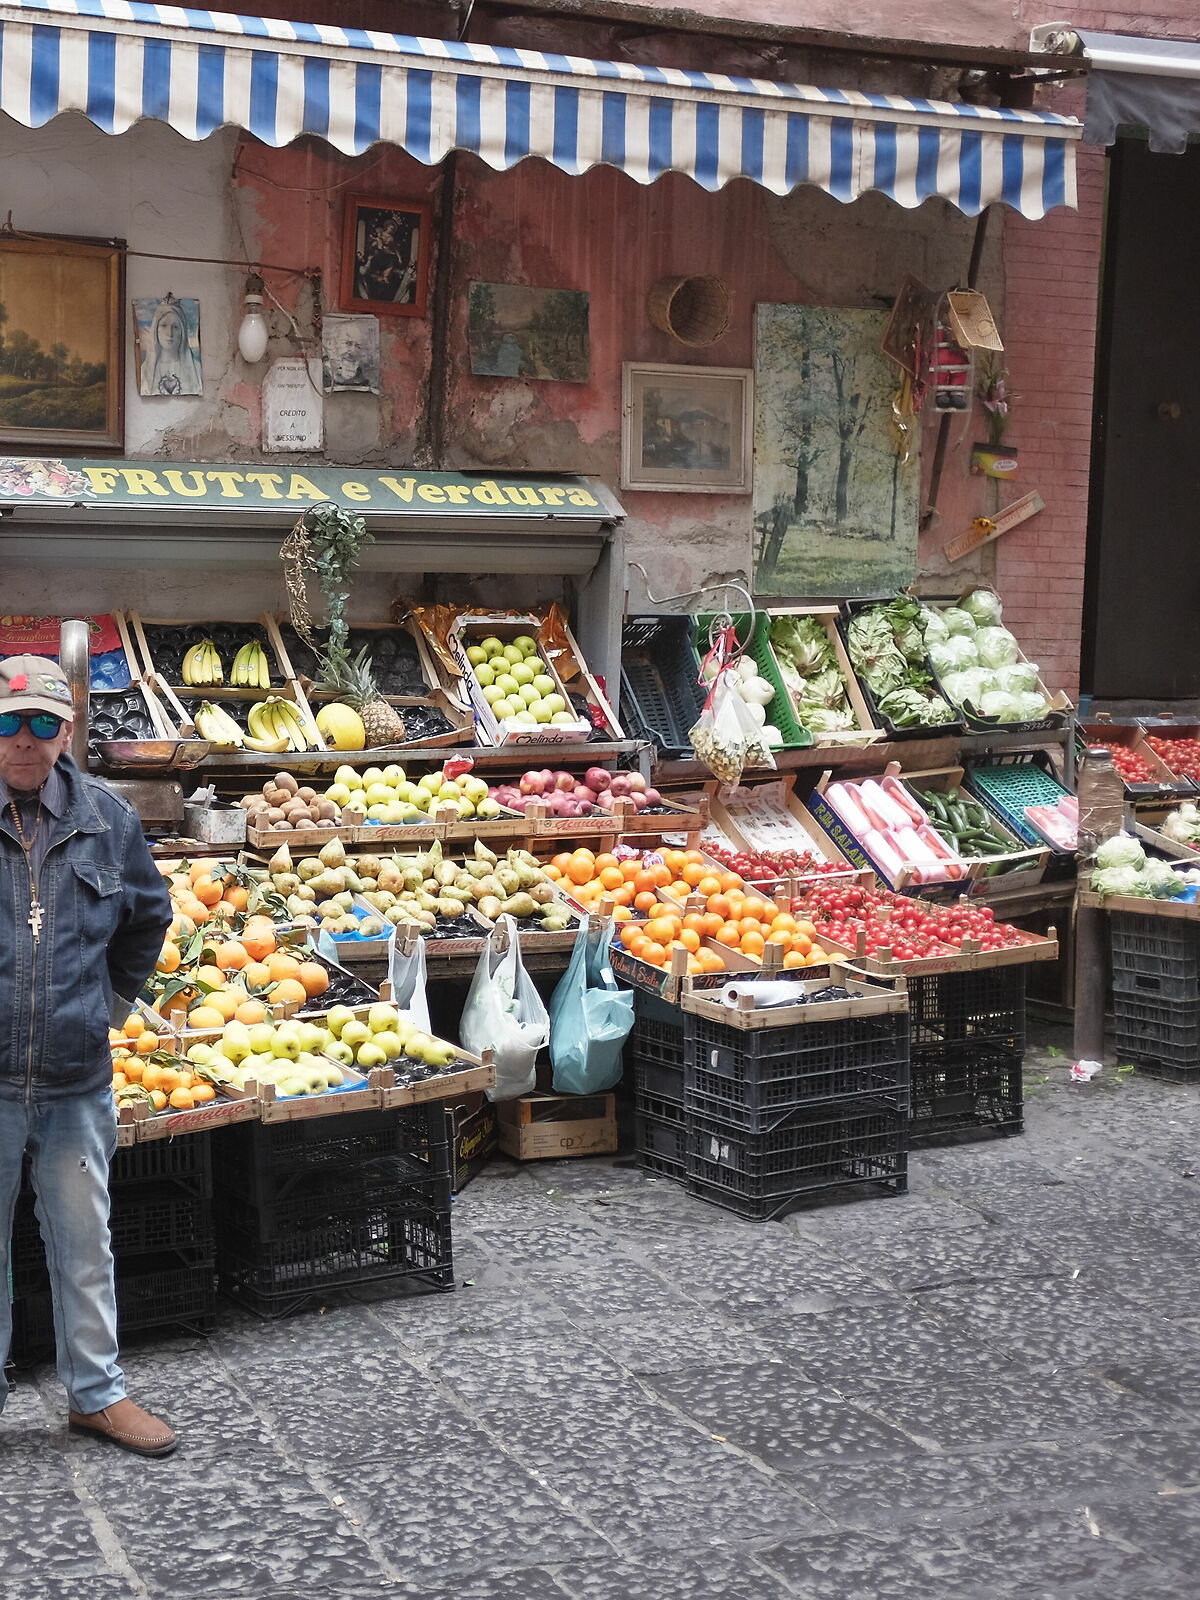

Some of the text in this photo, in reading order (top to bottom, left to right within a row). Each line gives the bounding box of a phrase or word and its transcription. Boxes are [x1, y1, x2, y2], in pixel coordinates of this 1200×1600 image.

[280, 409, 307, 417] CREDITO
[81, 467, 599, 507] FRUTTA e Verdura
[448, 633, 474, 692] Melinda
[515, 733, 563, 744] Melinda
[166, 1103, 248, 1129] Genuino
